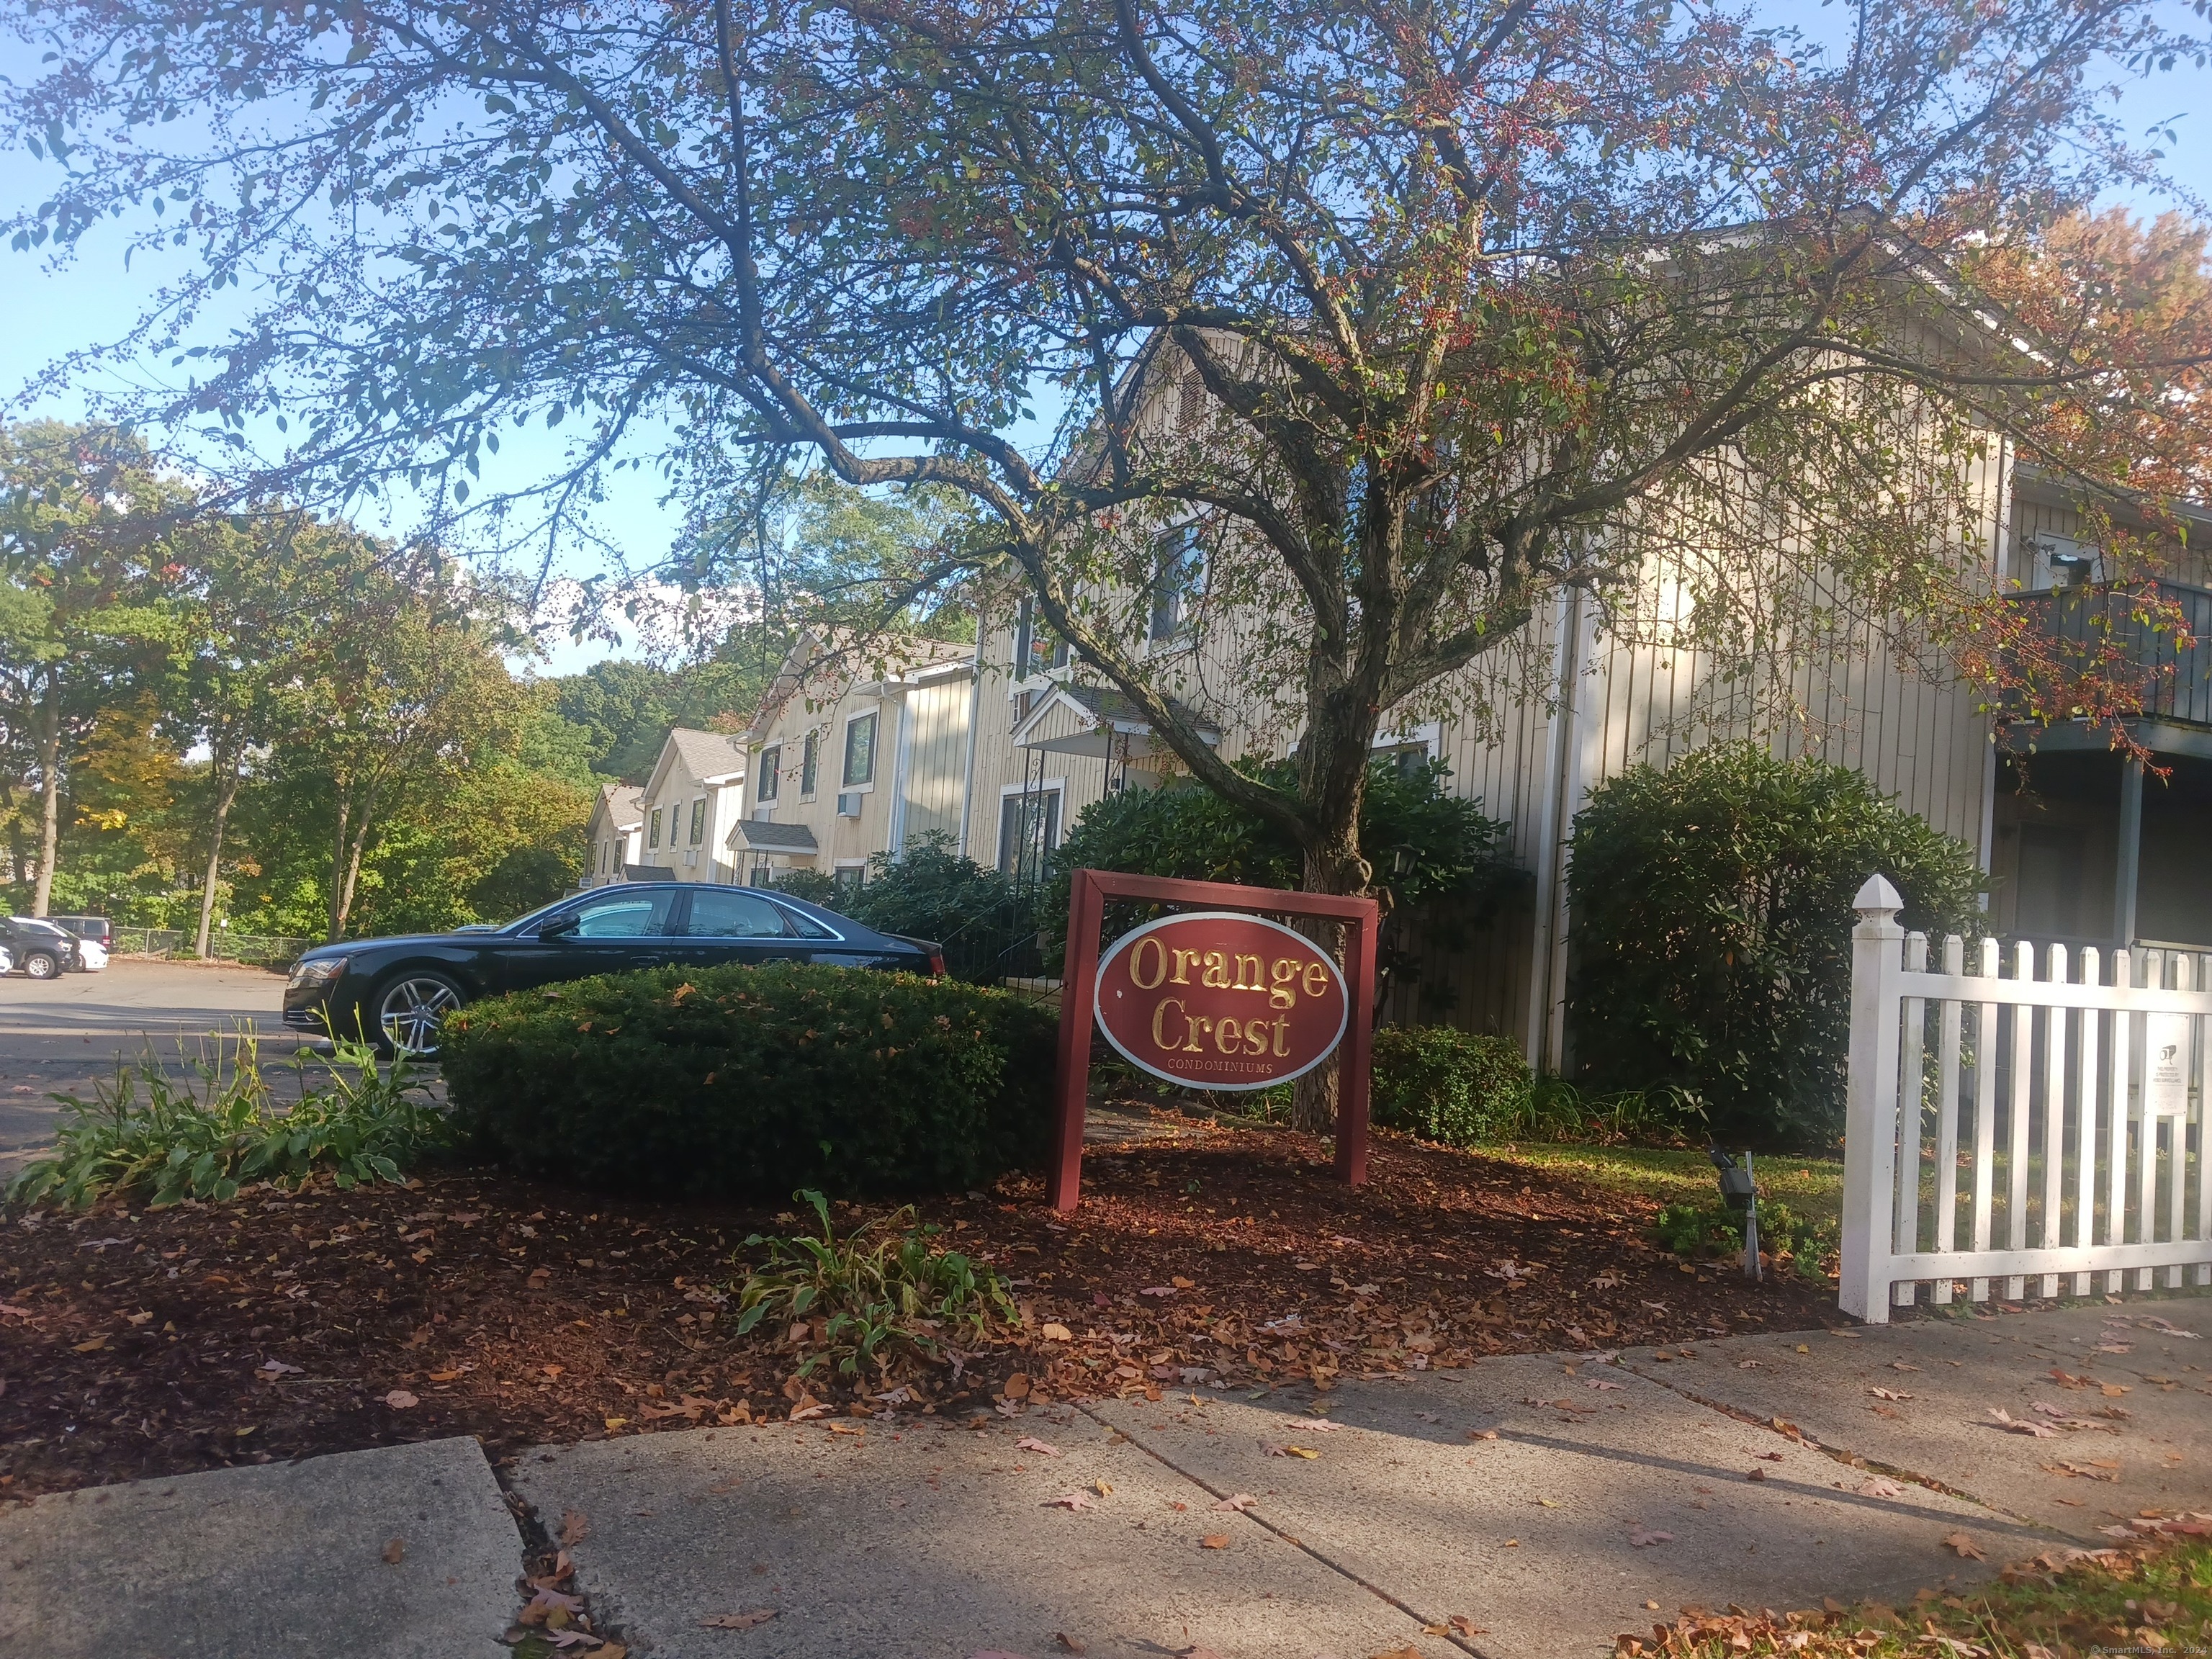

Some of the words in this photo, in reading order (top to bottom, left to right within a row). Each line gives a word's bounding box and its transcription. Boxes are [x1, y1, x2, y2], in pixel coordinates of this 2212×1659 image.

[1129, 936, 1329, 1010] Orange
[1152, 997, 1291, 1058] Crest
[1167, 1058, 1273, 1074] CONDOMINIUMS
